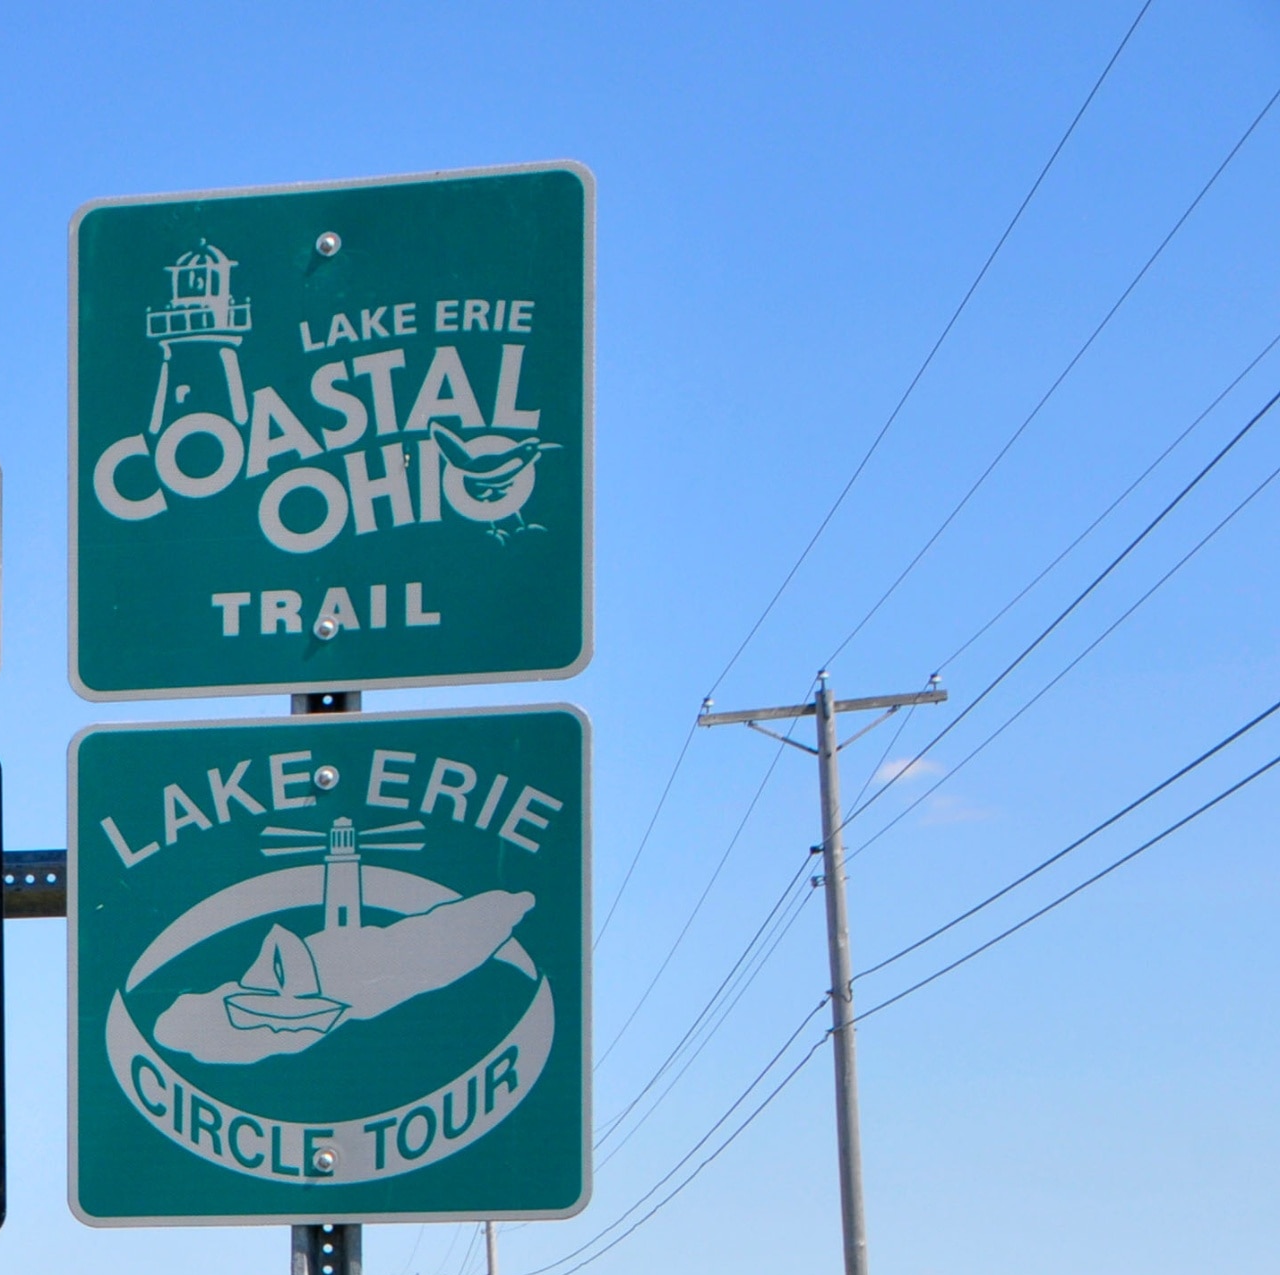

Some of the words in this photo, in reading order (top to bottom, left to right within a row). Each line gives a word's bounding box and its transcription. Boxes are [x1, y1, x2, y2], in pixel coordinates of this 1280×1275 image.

[299, 303, 417, 353] LAKE
[435, 300, 536, 333] ERIE
[93, 343, 541, 521] COASTAL
[258, 434, 537, 554] OHIO
[211, 582, 441, 636] TRAIL
[100, 749, 318, 869] LAKE
[365, 749, 564, 853] ERIE
[130, 1054, 335, 1178] CIRCLE
[363, 1044, 520, 1171] TOUR
